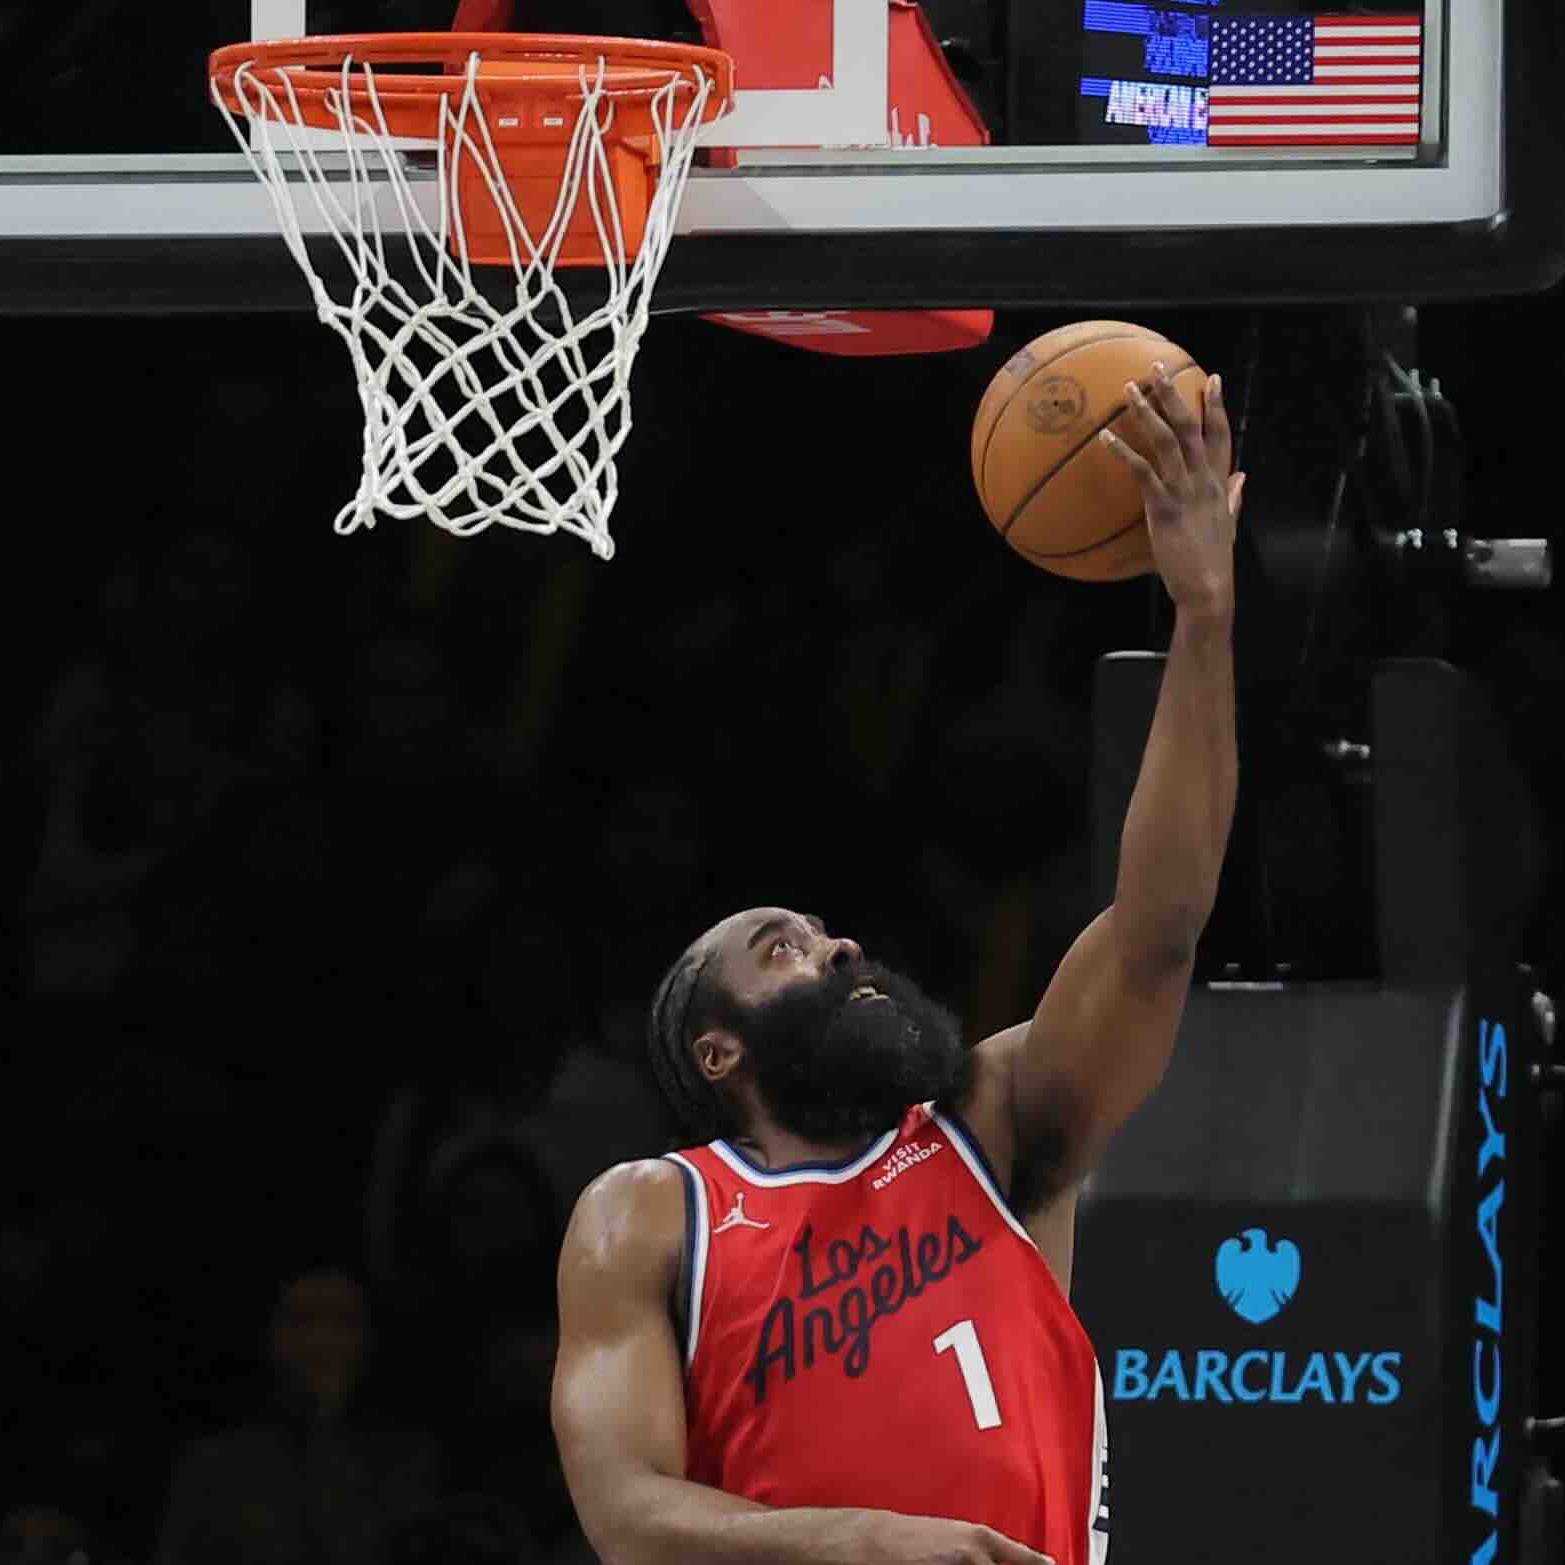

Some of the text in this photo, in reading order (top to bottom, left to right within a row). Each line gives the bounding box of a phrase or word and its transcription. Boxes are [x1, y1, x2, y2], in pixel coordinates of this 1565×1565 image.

[872, 1141, 944, 1191] RWANDA
[882, 1141, 922, 1171] VISIT
[793, 1223, 892, 1300] Los
[744, 1215, 983, 1408] Angeles
[932, 1319, 1003, 1431] 1
[1112, 1348, 1403, 1405] BARCLAYS
